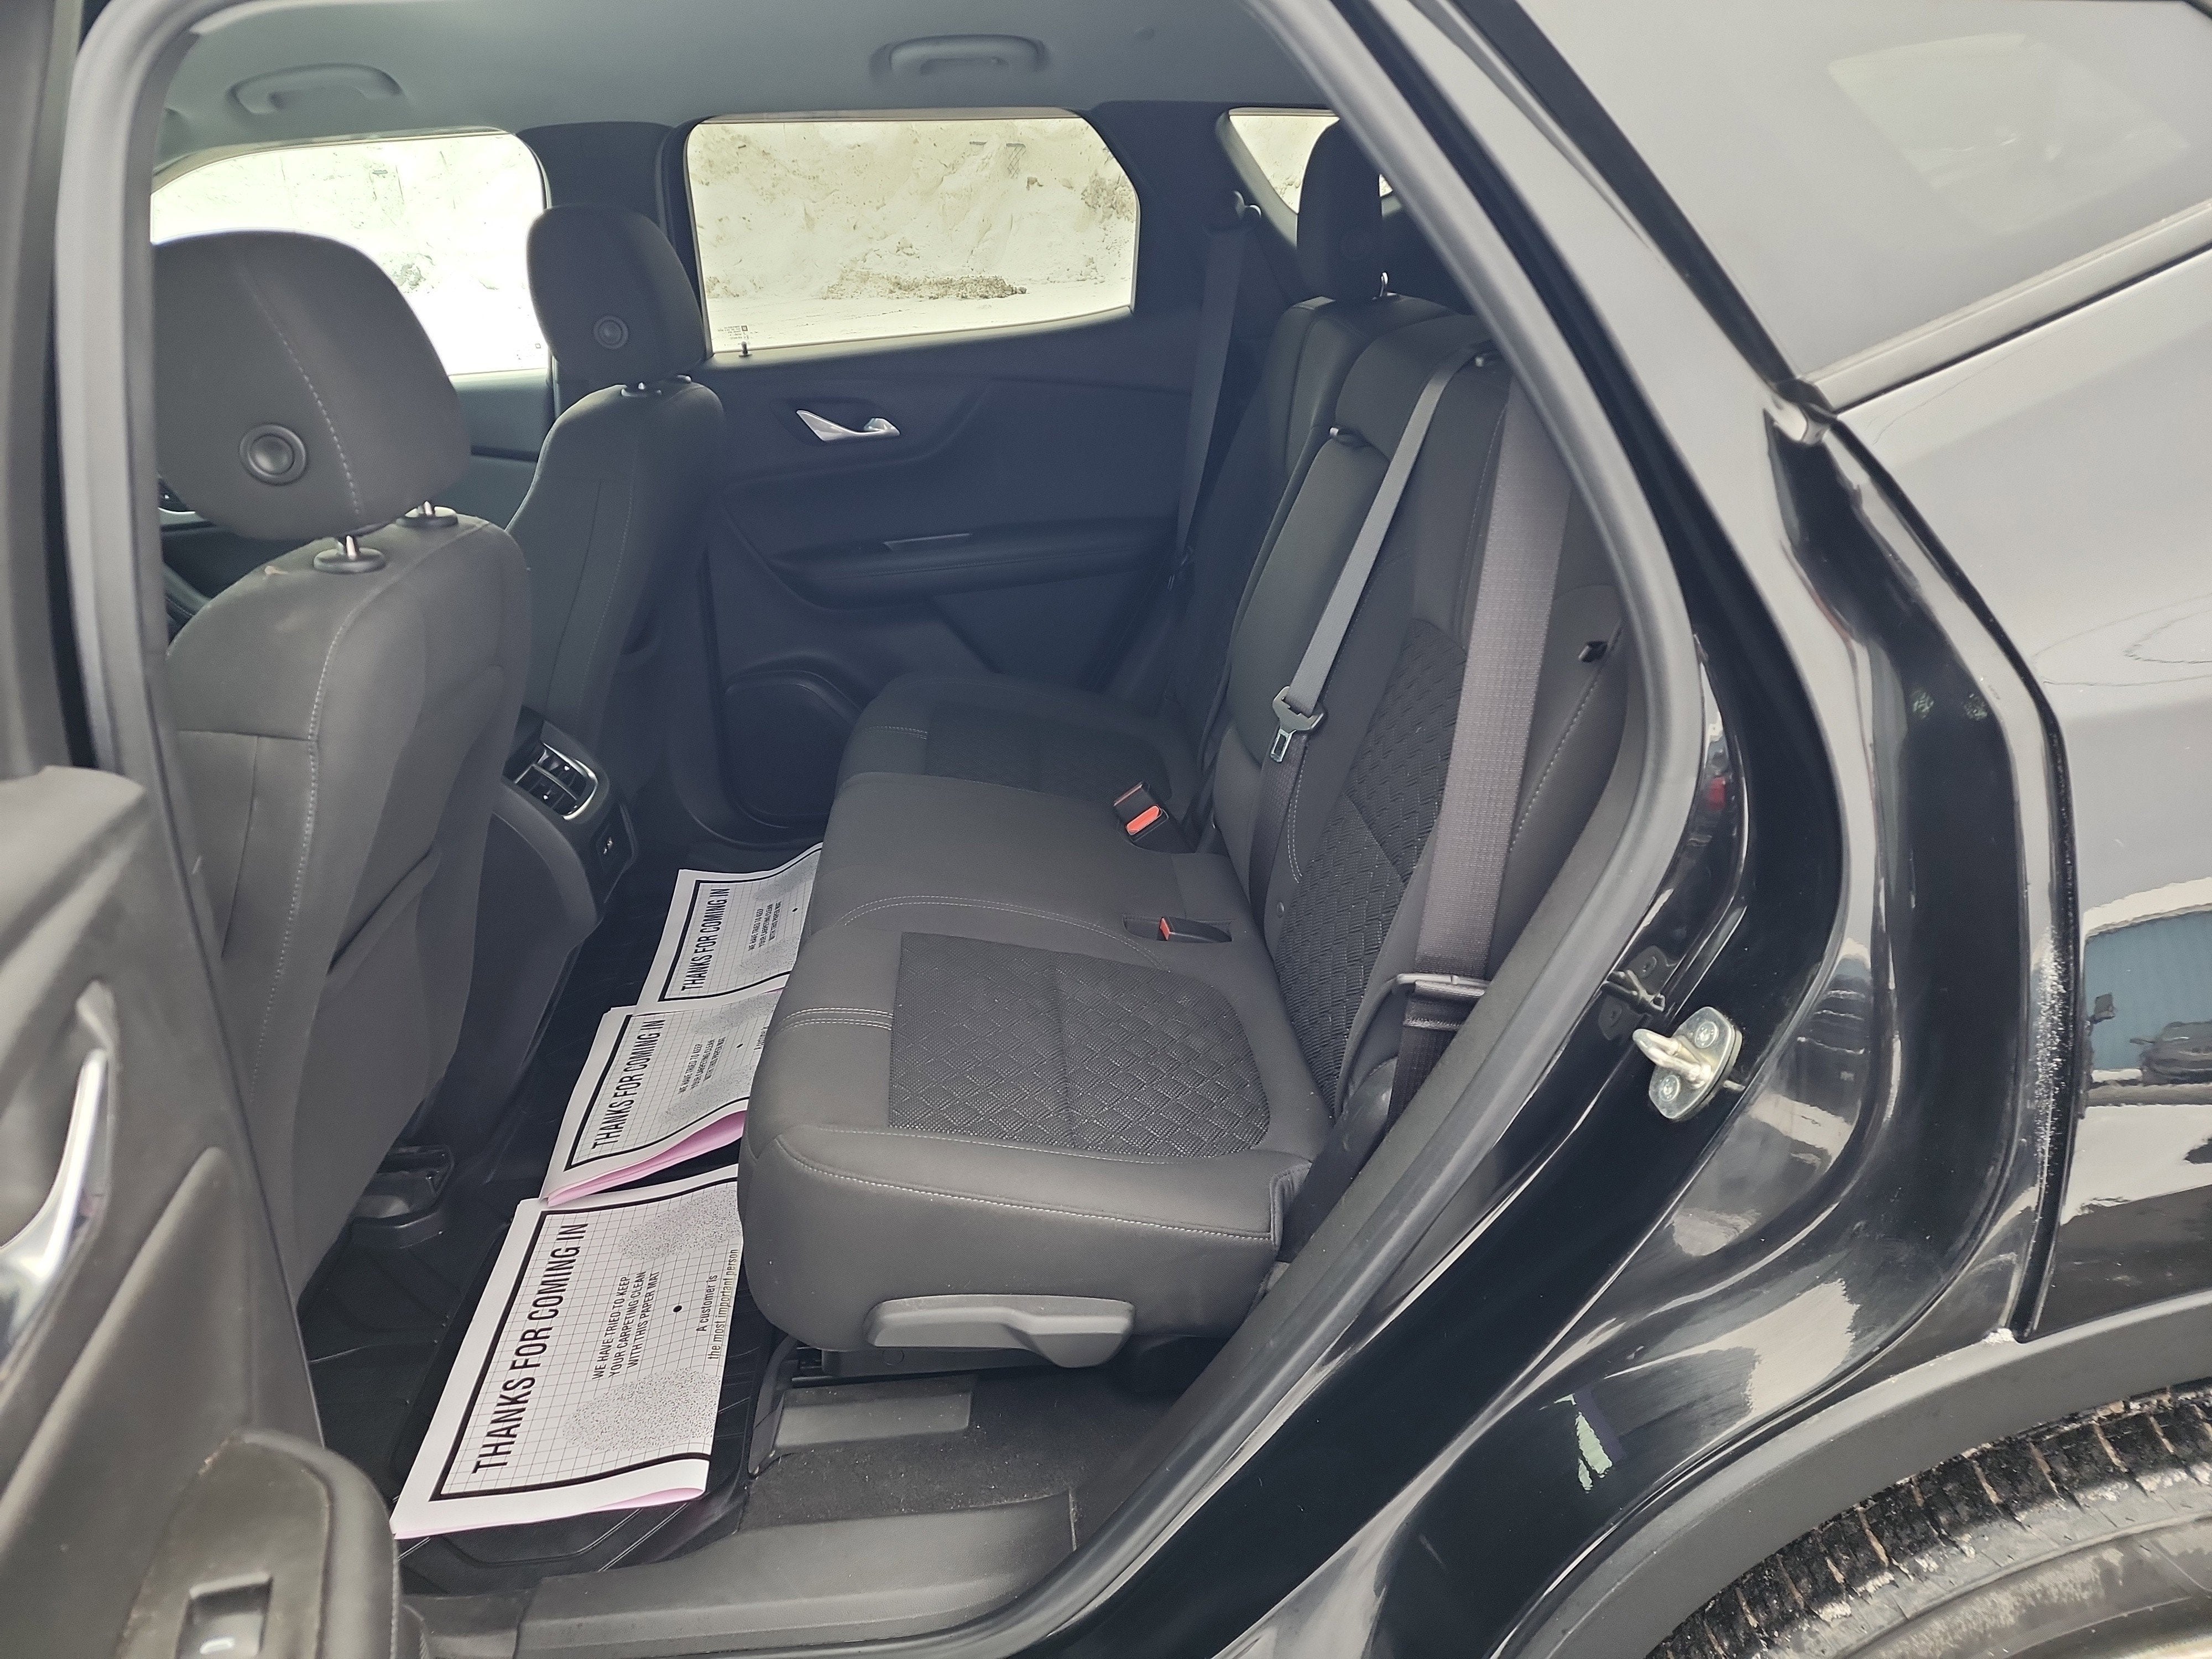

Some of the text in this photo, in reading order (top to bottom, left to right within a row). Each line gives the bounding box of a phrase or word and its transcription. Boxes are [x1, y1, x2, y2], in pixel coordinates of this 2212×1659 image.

[681, 889, 730, 991] THANKS FOR COMING IN
[592, 1020, 666, 1149] THANKS FOR COMING IN
[693, 1044, 702, 1053] KEEP
[472, 1223, 588, 1474] THANKS FOR COMING IN
[592, 1276, 630, 1380] WE HAVE TRIED TO KEEP
[608, 1271, 646, 1378] YOUR CARPETING CLEAN
[627, 1272, 659, 1368] WITH THIS PAPER MAT
[700, 1285, 716, 1323] customer
[707, 1249, 738, 1359] the most important person
